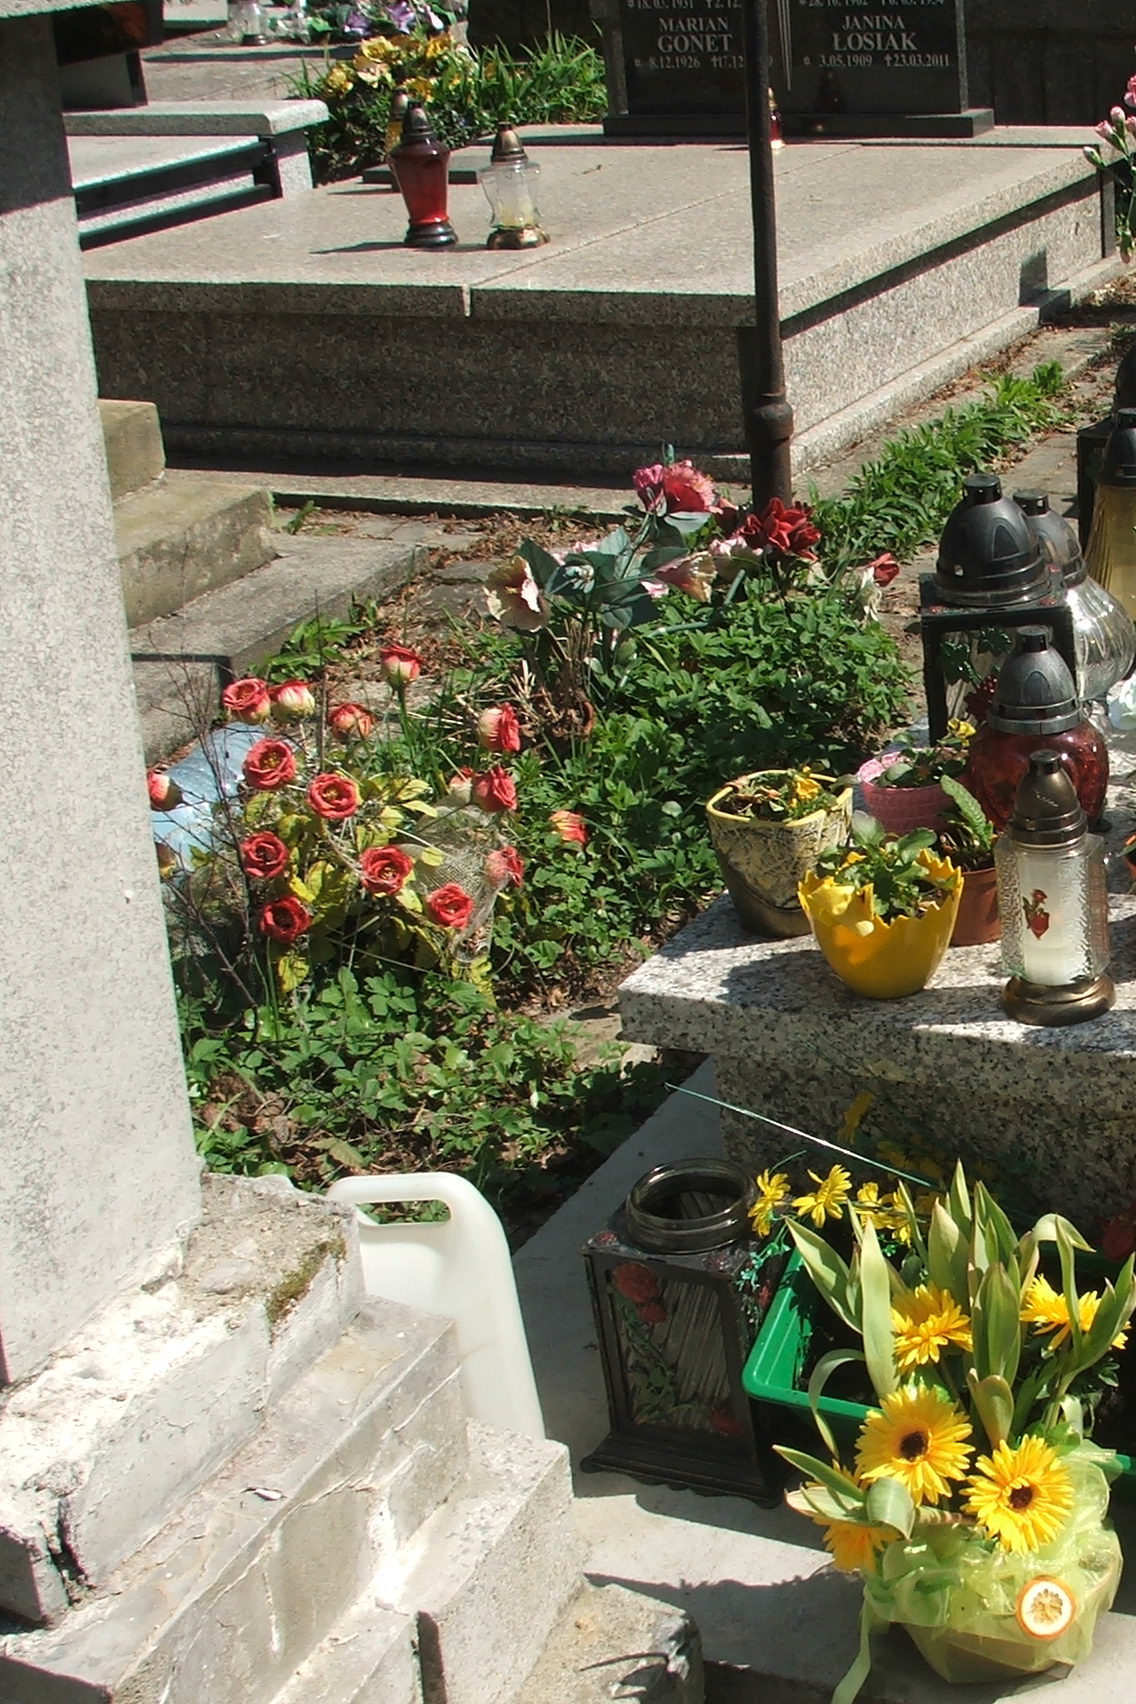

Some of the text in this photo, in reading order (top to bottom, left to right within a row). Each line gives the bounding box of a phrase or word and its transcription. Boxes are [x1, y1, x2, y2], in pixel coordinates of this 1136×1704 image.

[658, 17, 729, 32] MARIAN
[842, 15, 905, 30] JANINA
[657, 33, 734, 53] GONET
[819, 54, 873, 68] 3.05.1909
